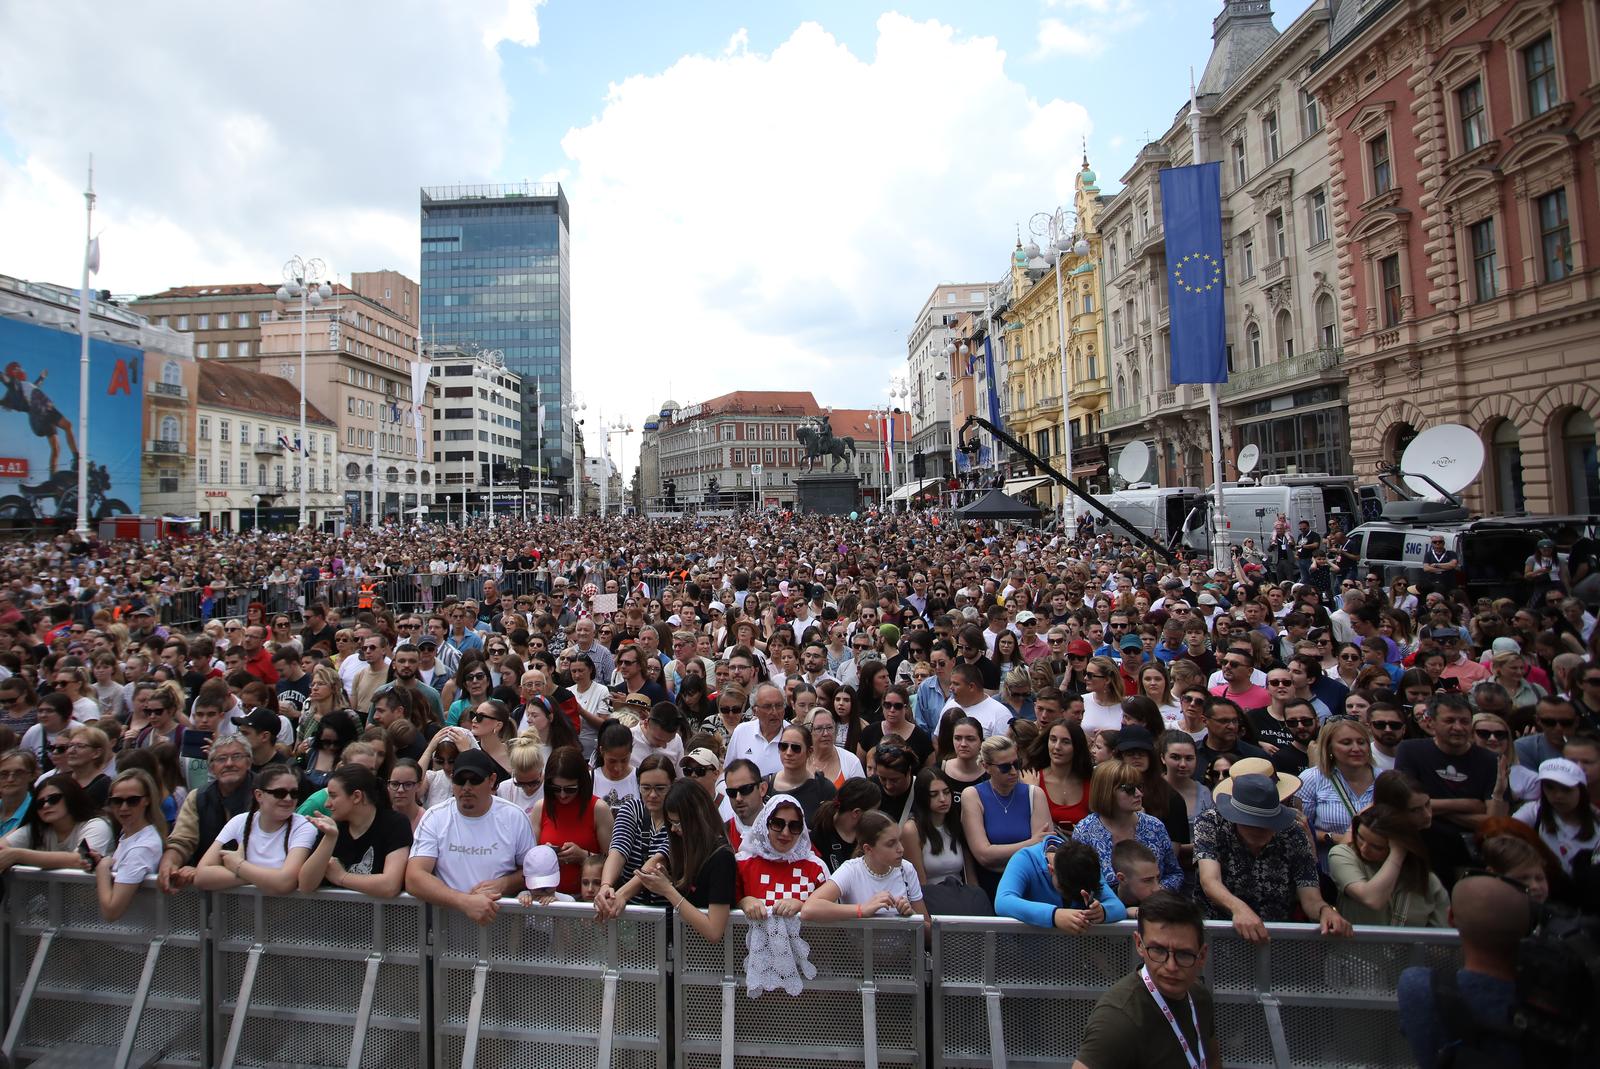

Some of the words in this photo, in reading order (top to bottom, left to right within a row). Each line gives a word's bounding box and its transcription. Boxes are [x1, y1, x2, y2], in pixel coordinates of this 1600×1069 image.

[108, 357, 138, 395] A1
[1405, 542, 1421, 555] SNG
[1261, 729, 1285, 738] PLEASE
